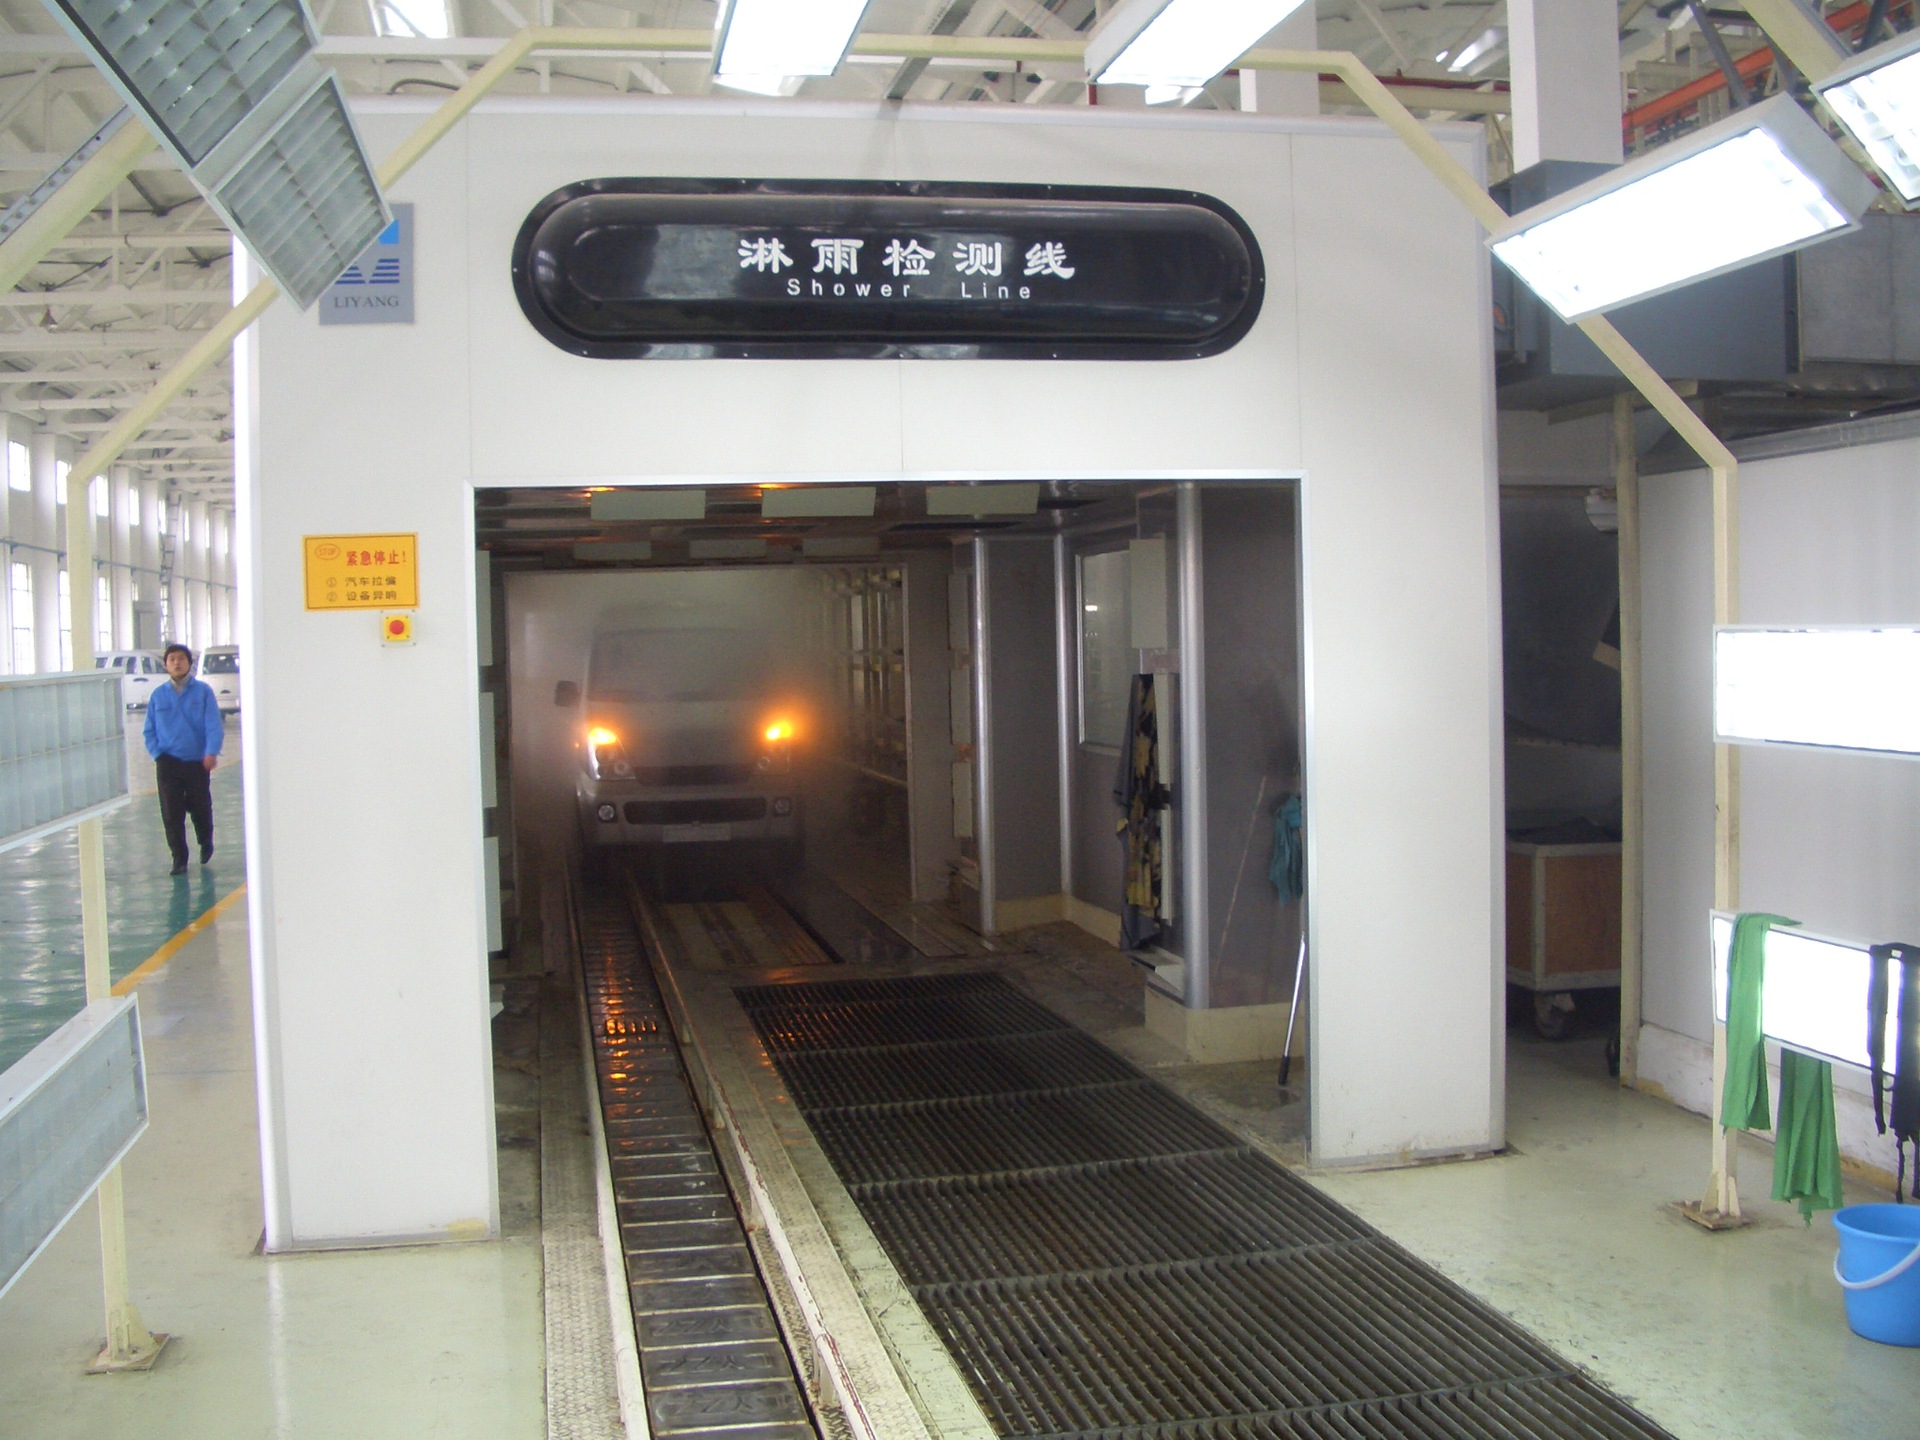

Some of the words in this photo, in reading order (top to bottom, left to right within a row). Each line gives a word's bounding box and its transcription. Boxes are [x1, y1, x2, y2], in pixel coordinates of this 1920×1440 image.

[738, 237, 1075, 279] 淋雨检测线
[787, 278, 911, 297] Shower
[961, 282, 1031, 299] Line
[334, 296, 399, 308] LIYANG
